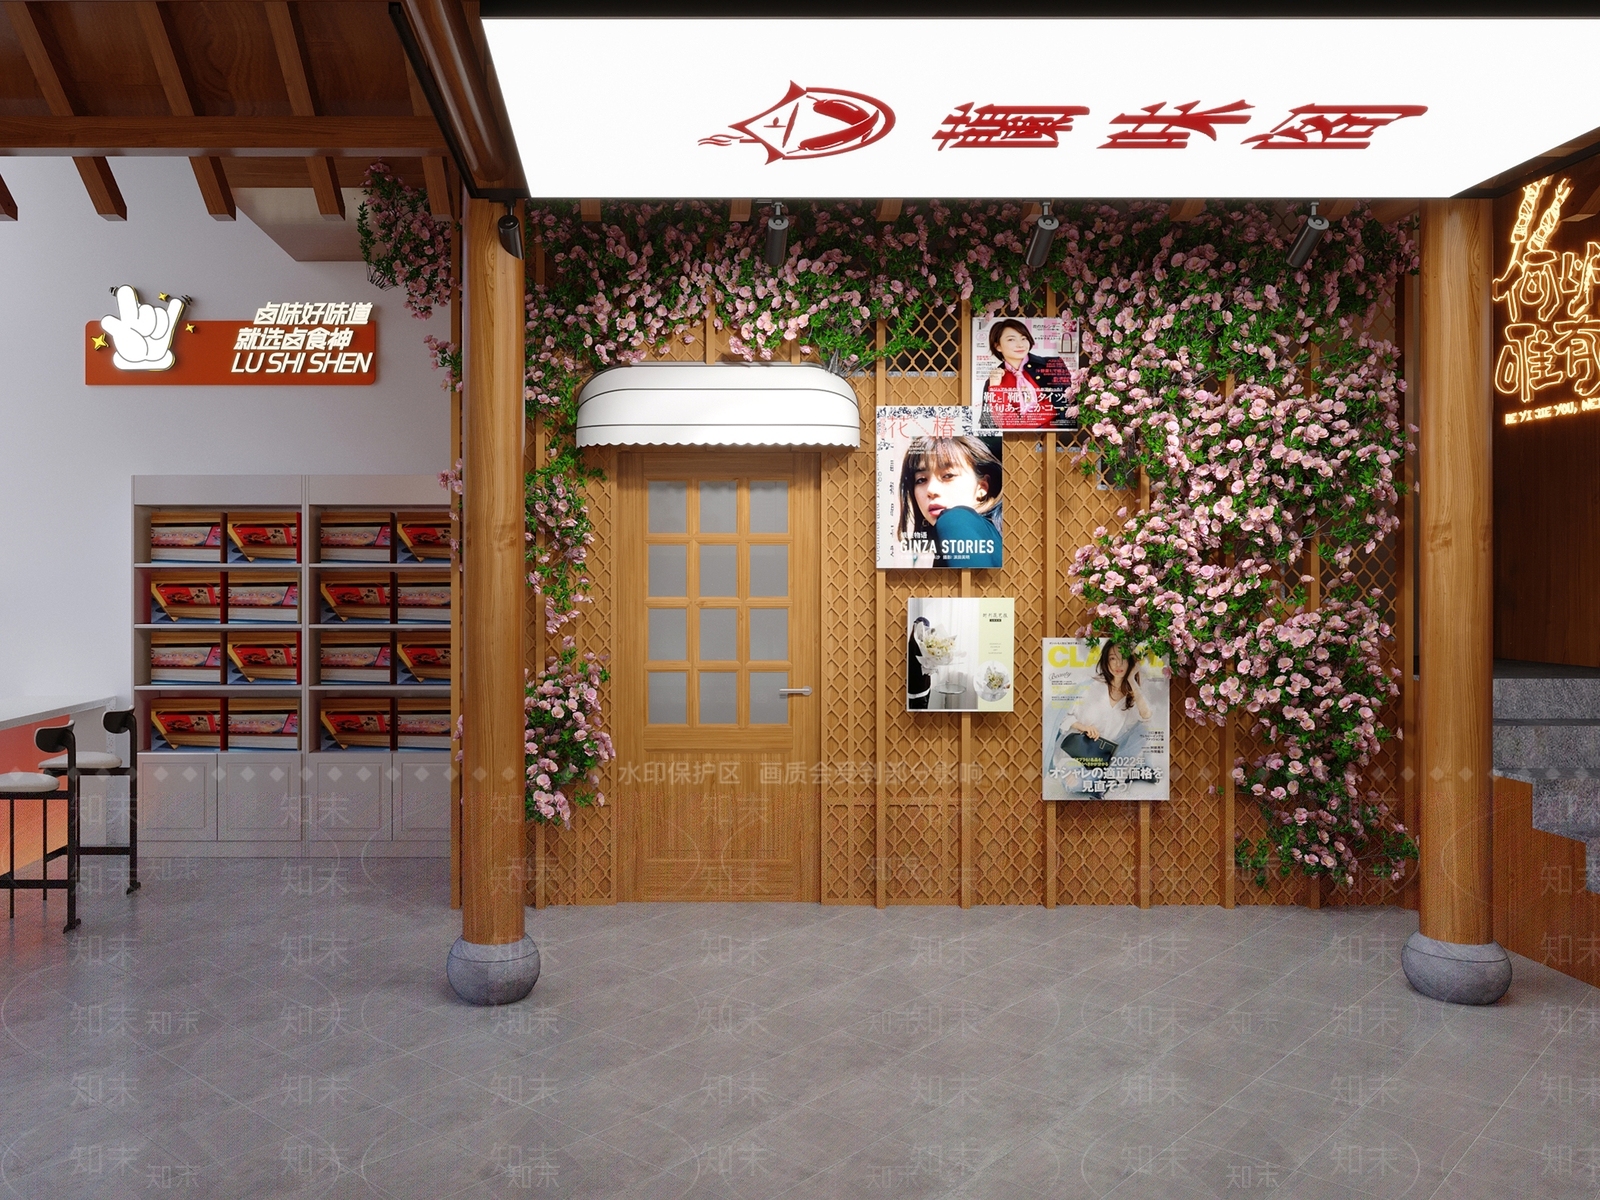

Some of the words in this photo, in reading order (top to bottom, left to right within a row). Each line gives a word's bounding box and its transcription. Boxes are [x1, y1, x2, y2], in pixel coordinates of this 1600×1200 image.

[253, 301, 374, 326] 卤味好味道
[233, 326, 354, 350] 就选卤食神
[231, 352, 265, 373] LU
[265, 352, 306, 373] SHI
[306, 352, 374, 373] SHEN
[900, 539, 937, 553] GINZA
[941, 539, 994, 553] STORIES
[1111, 756, 1146, 767] 2022年
[1050, 767, 1164, 779] オシャレの適正価格を
